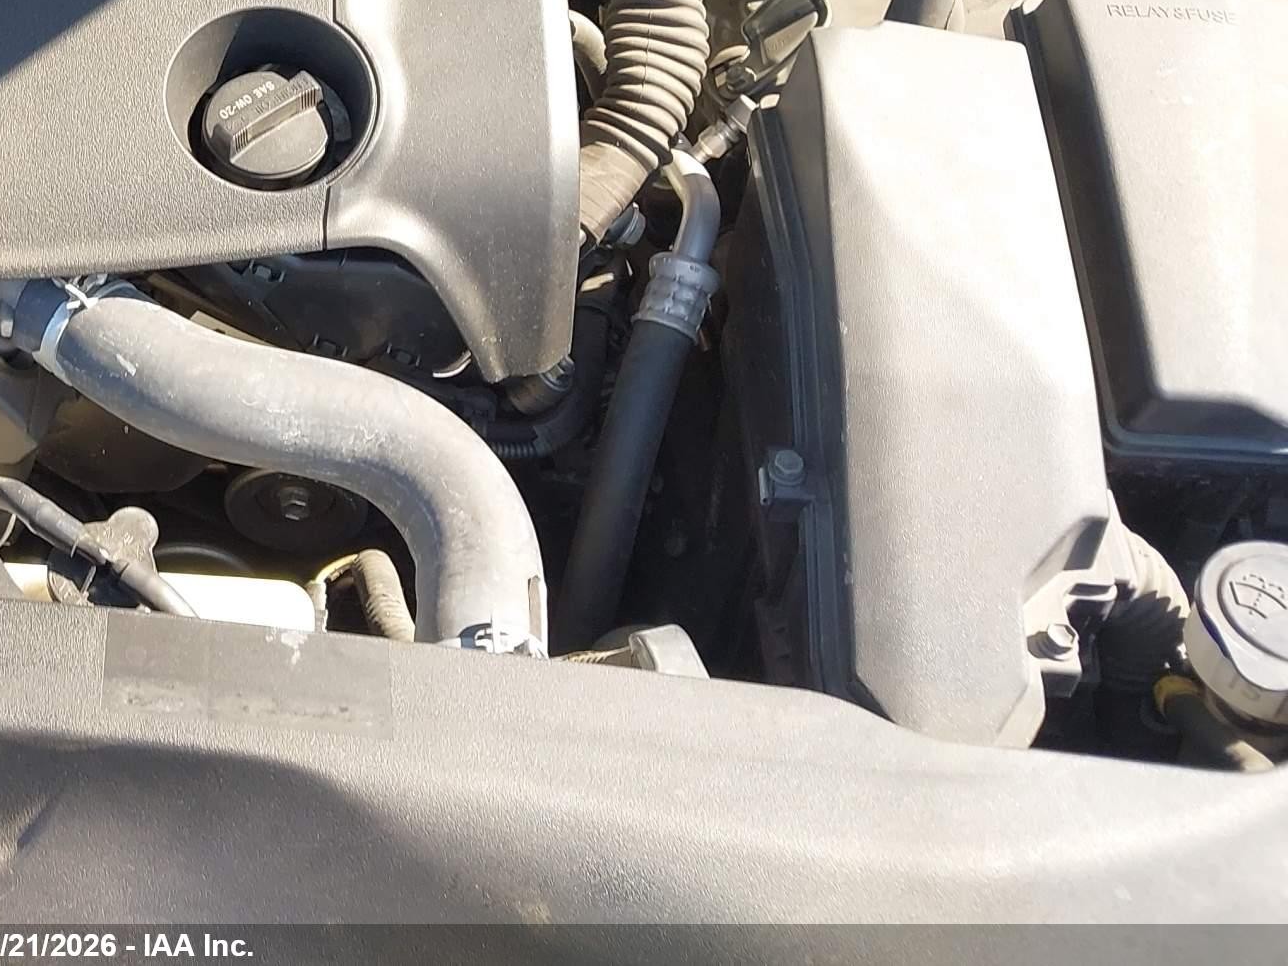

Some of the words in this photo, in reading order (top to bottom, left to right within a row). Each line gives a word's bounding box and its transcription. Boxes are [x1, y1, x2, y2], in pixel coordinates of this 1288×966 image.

[1106, 3, 1238, 25] RELAY&FUSE
[252, 80, 275, 99] SAE
[219, 94, 253, 120] 0W-20
